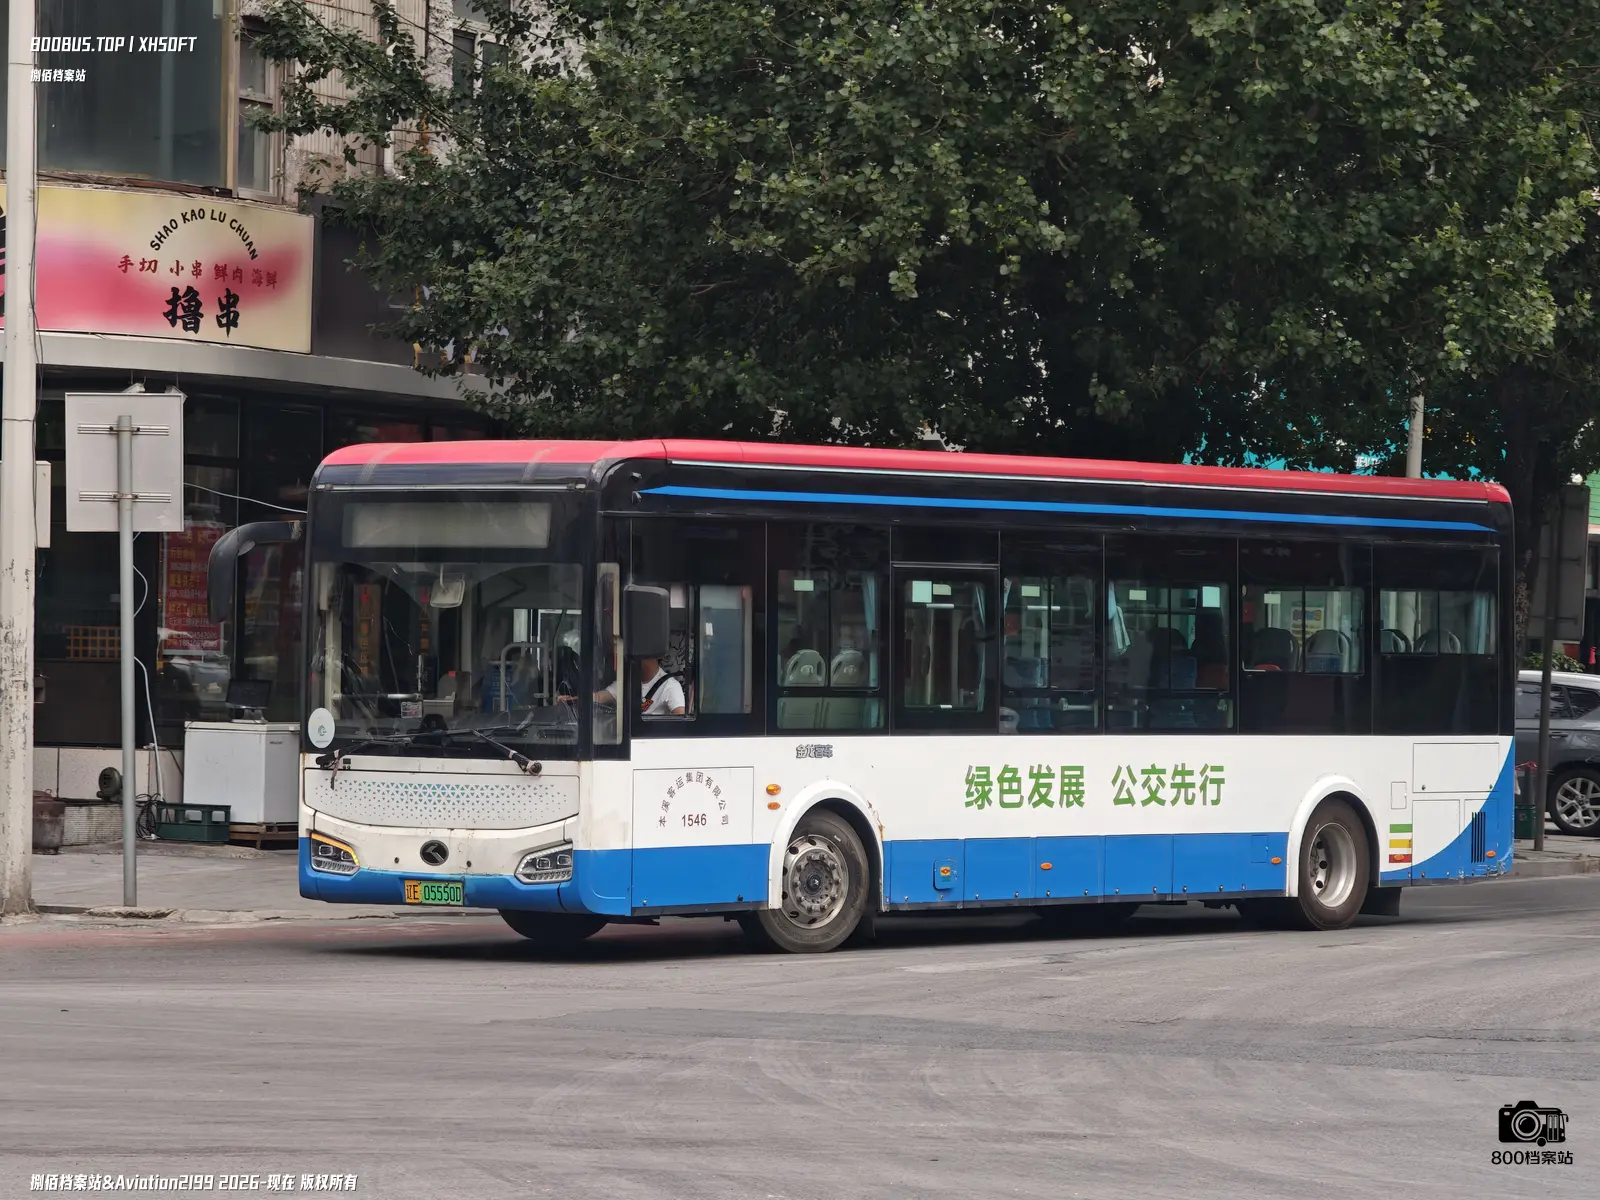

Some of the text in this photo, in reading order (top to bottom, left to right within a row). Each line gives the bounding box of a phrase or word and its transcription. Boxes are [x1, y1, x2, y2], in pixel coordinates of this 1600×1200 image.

[150, 208, 258, 260] SHAO KAO LU CHUAN
[118, 254, 158, 274] 手切
[169, 259, 203, 279] 小串
[213, 263, 243, 284] 鲜肉
[162, 285, 240, 338] 撸串
[658, 771, 729, 827] 本溪客运集团有限公司
[965, 763, 1226, 810] 绿色发展 公交先行
[681, 813, 707, 827] 1546
